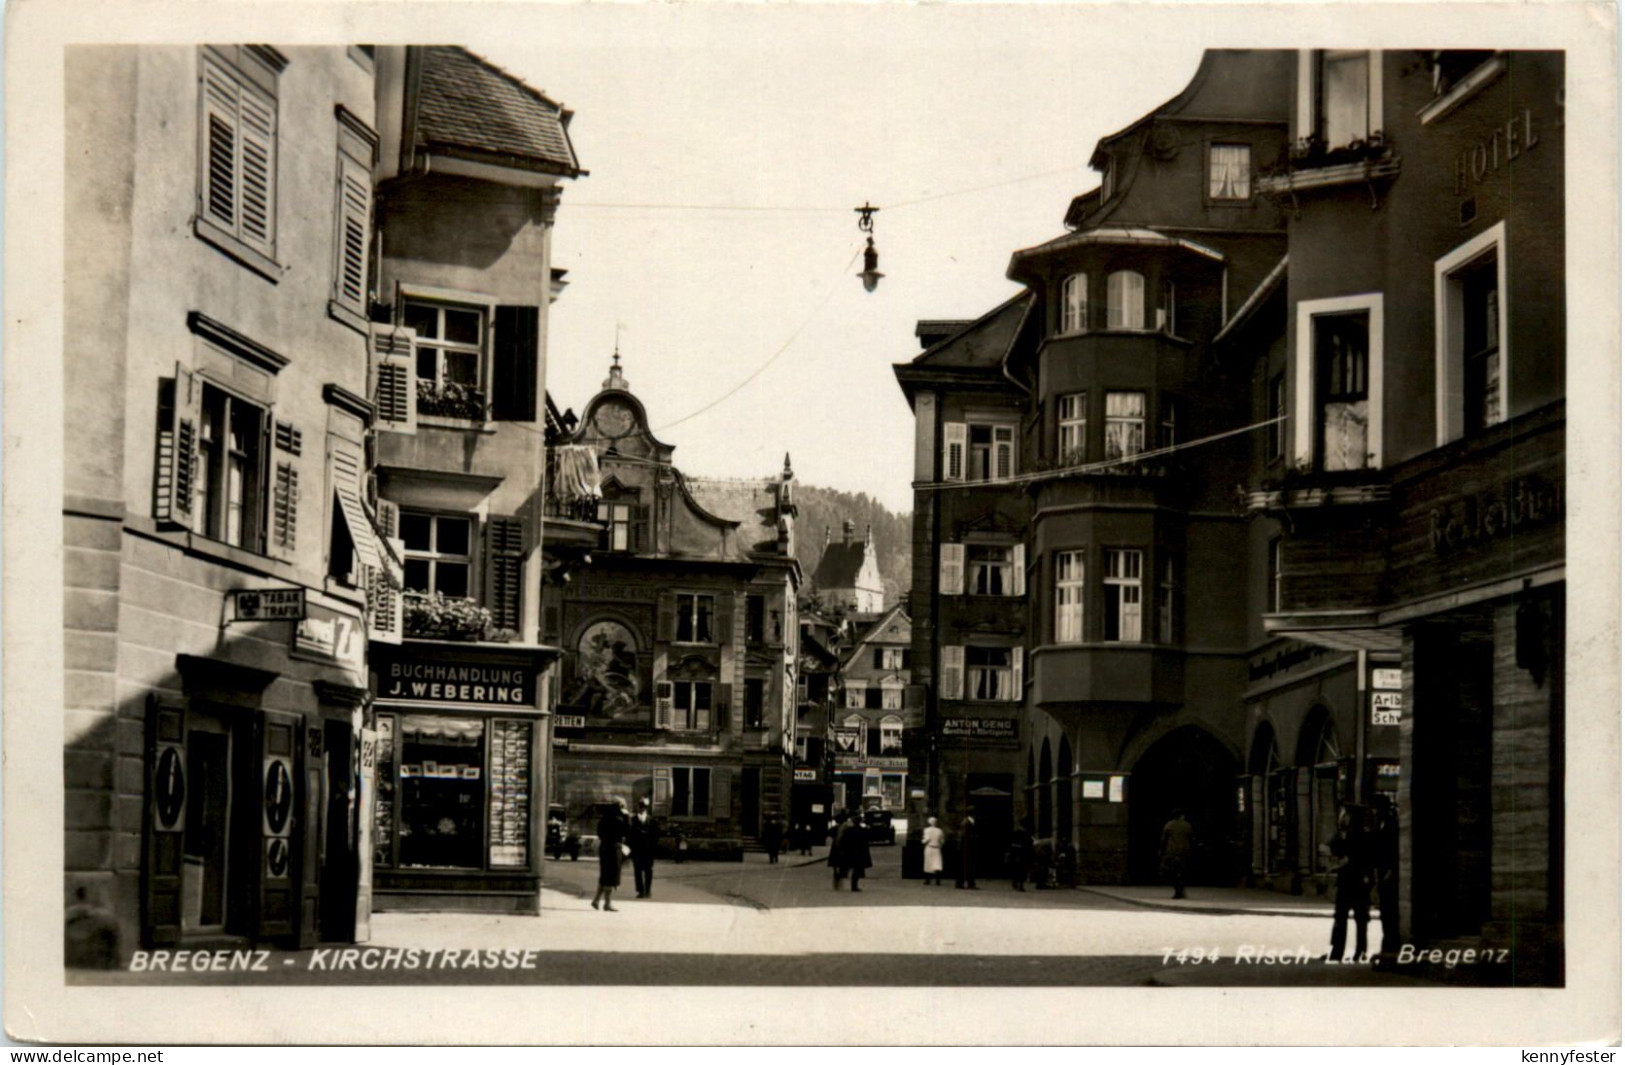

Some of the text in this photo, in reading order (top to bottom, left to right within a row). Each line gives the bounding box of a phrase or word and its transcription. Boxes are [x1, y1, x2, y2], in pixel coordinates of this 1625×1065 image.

[1454, 109, 1540, 197] HOTEL
[263, 592, 301, 604] TABAK
[263, 605, 301, 617] TRAFIK
[391, 663, 523, 685] BUCHHANDLUNG
[389, 681, 523, 703] J. WEBERING
[944, 718, 980, 729] ANTON
